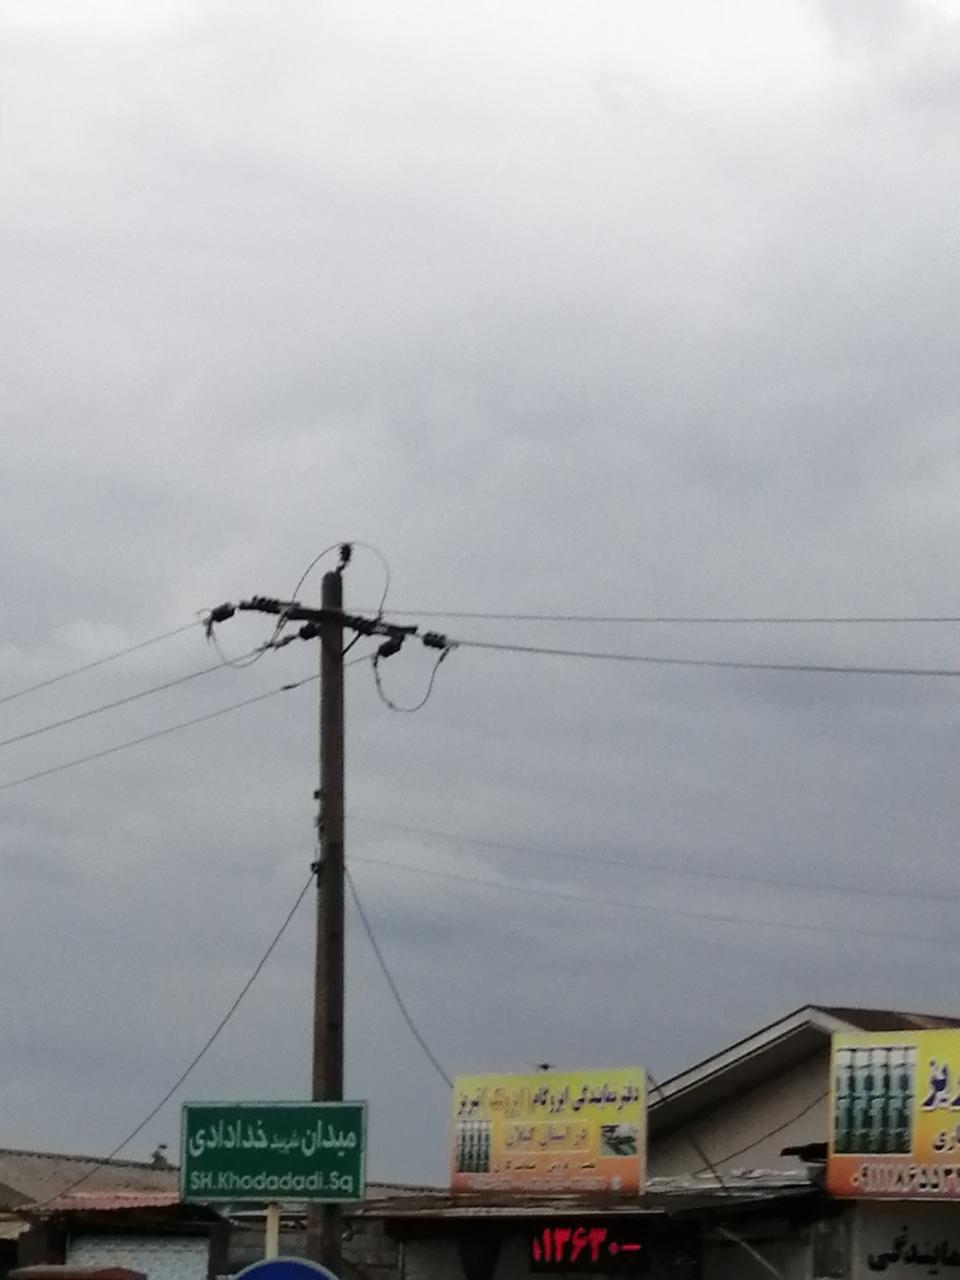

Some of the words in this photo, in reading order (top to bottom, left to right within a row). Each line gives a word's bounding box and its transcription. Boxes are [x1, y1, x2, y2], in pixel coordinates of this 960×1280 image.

[190, 1119, 269, 1157] خدادادی
[269, 1129, 301, 1154] شهید
[301, 1119, 357, 1157] میدان
